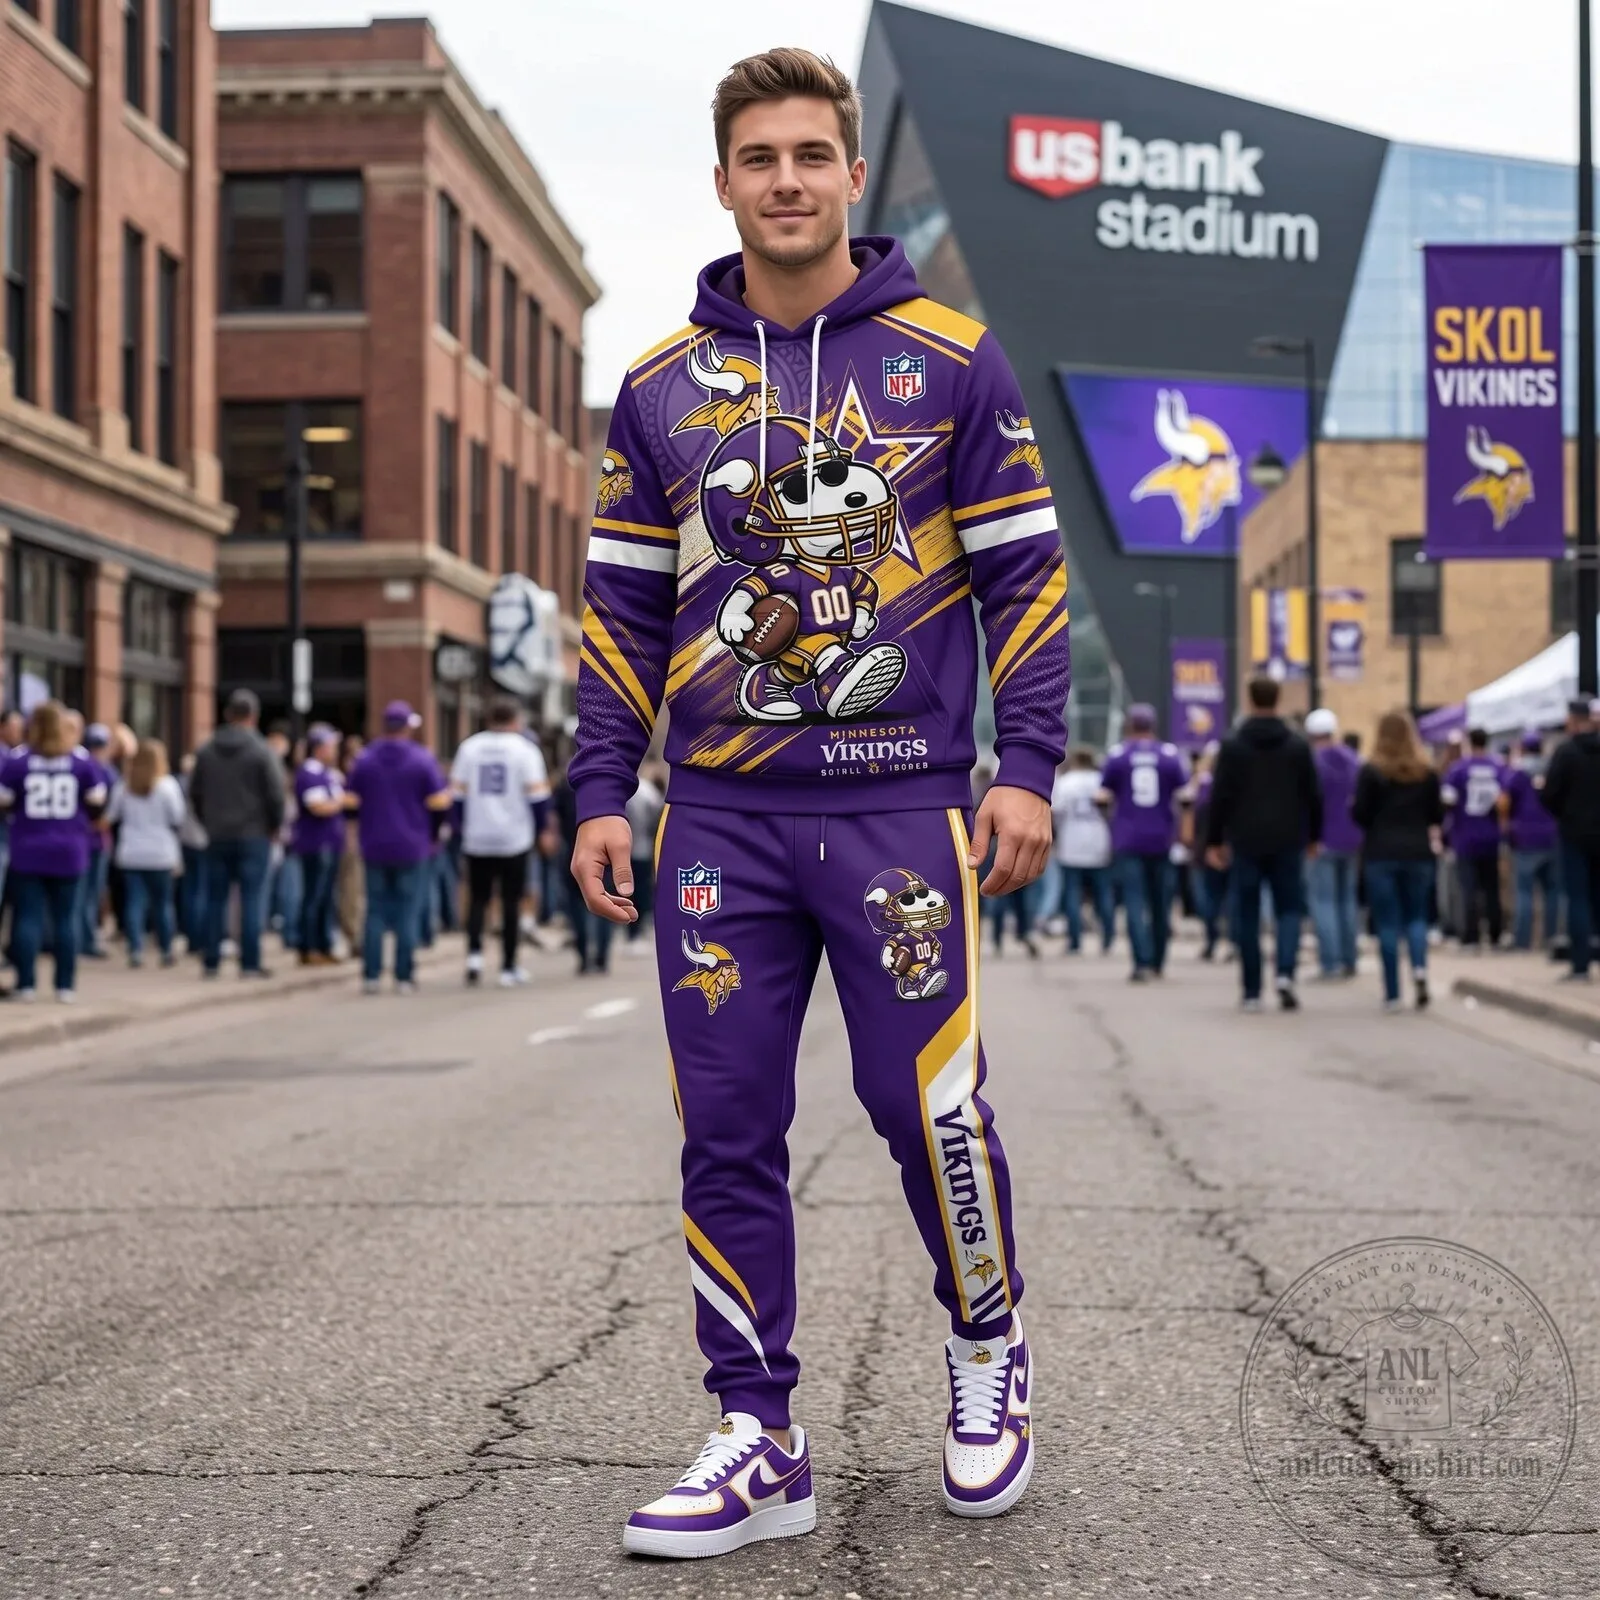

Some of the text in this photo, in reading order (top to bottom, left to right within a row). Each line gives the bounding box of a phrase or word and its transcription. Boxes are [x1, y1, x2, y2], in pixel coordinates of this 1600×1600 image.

[1096, 192, 1319, 262] stadium
[1434, 306, 1556, 364] SKOL
[888, 374, 922, 398] NFL
[1433, 368, 1558, 407] VIKINGS
[810, 585, 850, 626] 00
[820, 738, 928, 763] VIKINGS
[830, 726, 916, 739] MINNESOTA
[1131, 766, 1160, 807] 9
[683, 886, 716, 912] NFL
[915, 941, 932, 960] 00
[934, 1104, 988, 1245] VIKINGS
